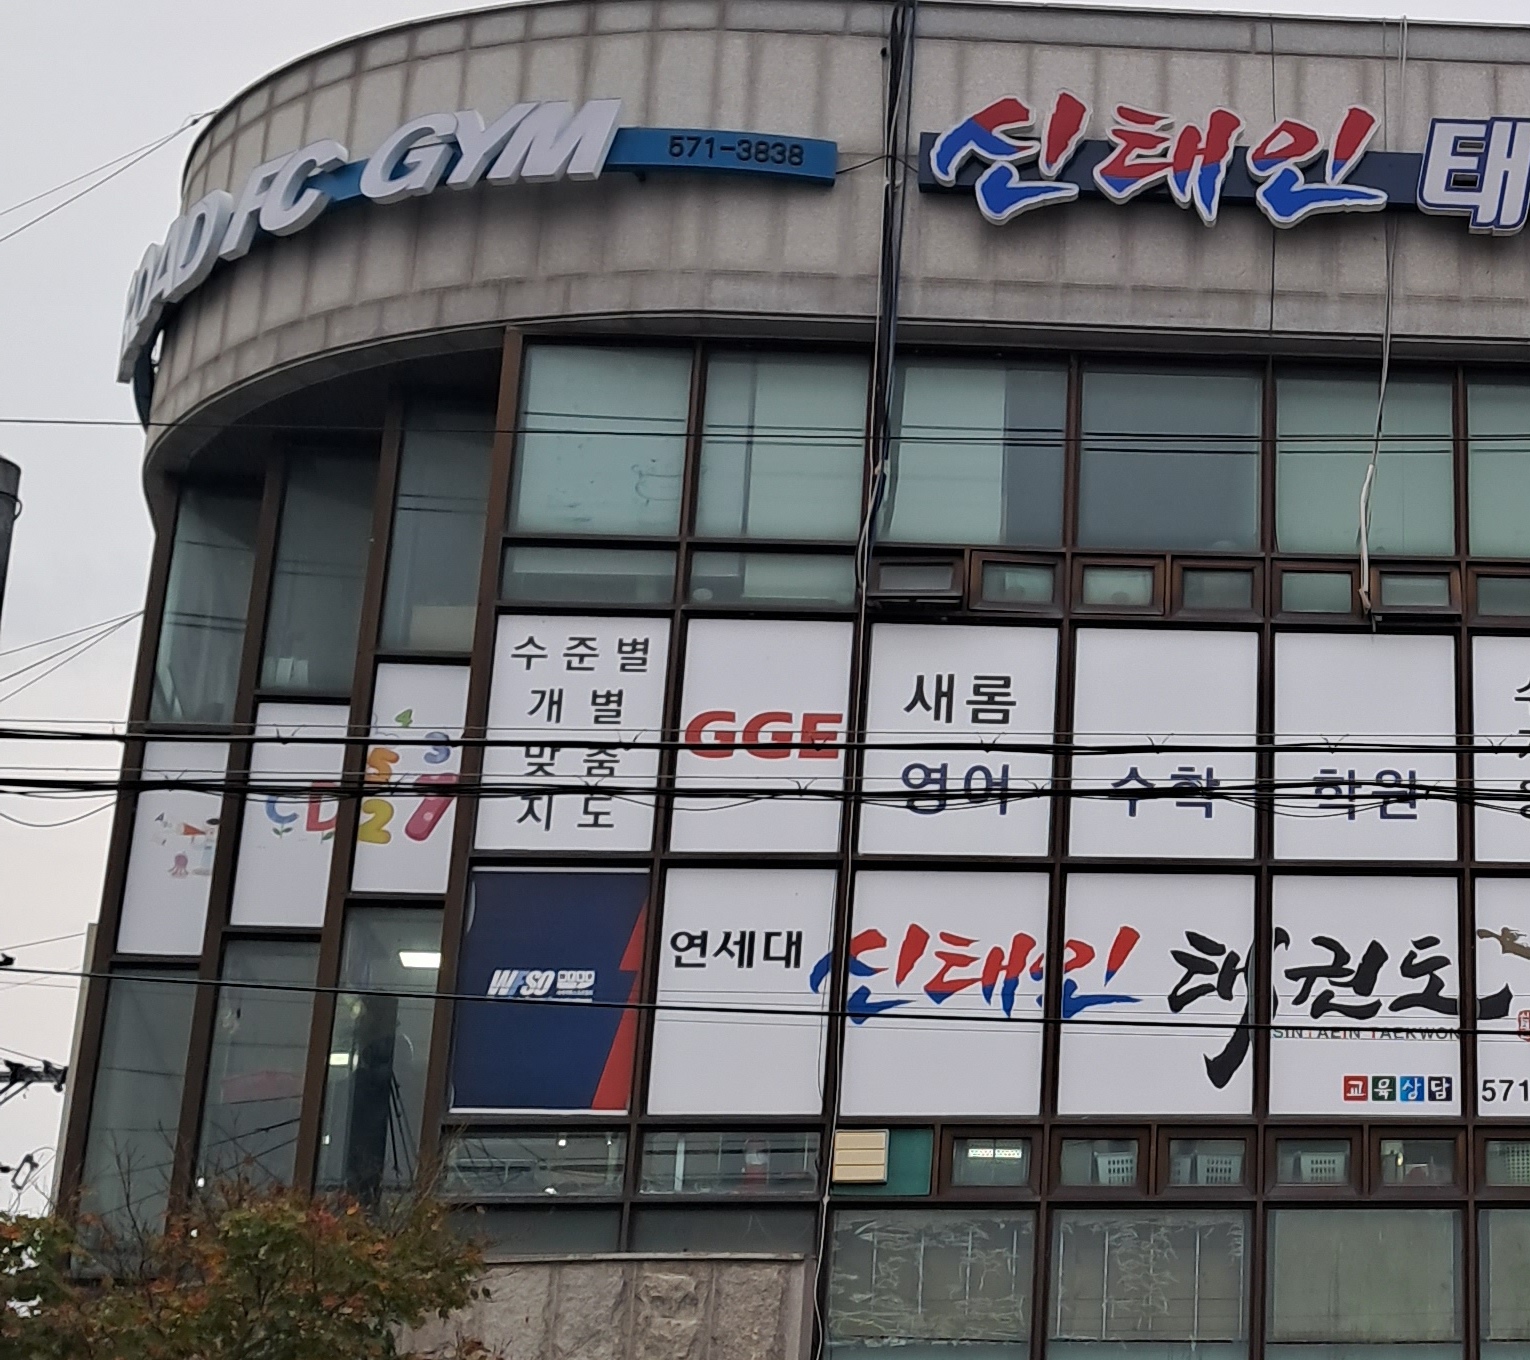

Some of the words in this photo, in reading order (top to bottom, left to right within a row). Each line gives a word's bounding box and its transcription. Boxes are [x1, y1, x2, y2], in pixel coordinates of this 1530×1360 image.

[668, 134, 805, 168] 571-3838
[930, 91, 1388, 228] 신태인
[219, 138, 350, 261] FC
[358, 99, 622, 205] GYM
[511, 635, 649, 673] 수준별
[529, 688, 624, 725] 개별
[904, 673, 1017, 724] 새롬
[684, 711, 843, 760] GGE
[901, 762, 1010, 816] 영어
[516, 792, 615, 832] 지도
[669, 930, 803, 969] 연세대
[1345, 1076, 1453, 1102] 교육상담
